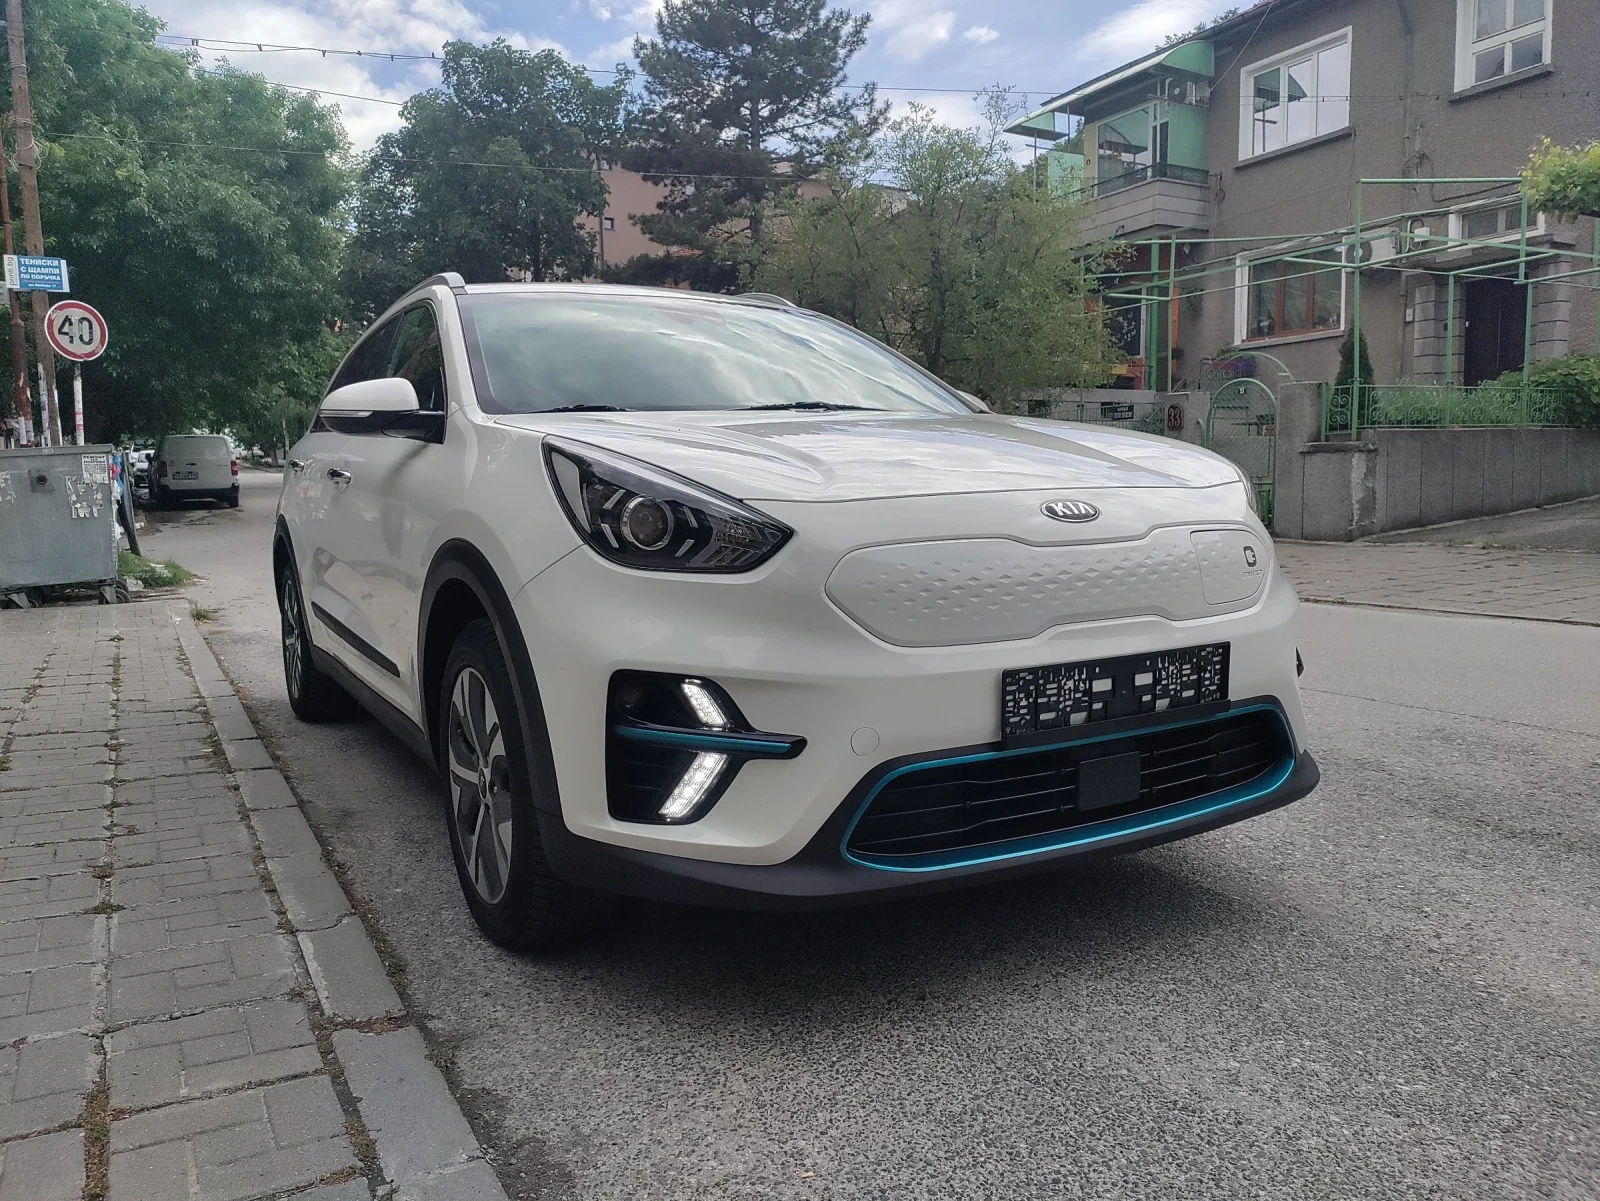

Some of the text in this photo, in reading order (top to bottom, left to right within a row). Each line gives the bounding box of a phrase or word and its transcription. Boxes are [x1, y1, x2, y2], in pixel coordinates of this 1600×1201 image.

[20, 258, 59, 266] ТЕНИСКИ
[58, 314, 94, 346] 40
[1168, 407, 1181, 428] 33
[1047, 501, 1095, 516] KIA
